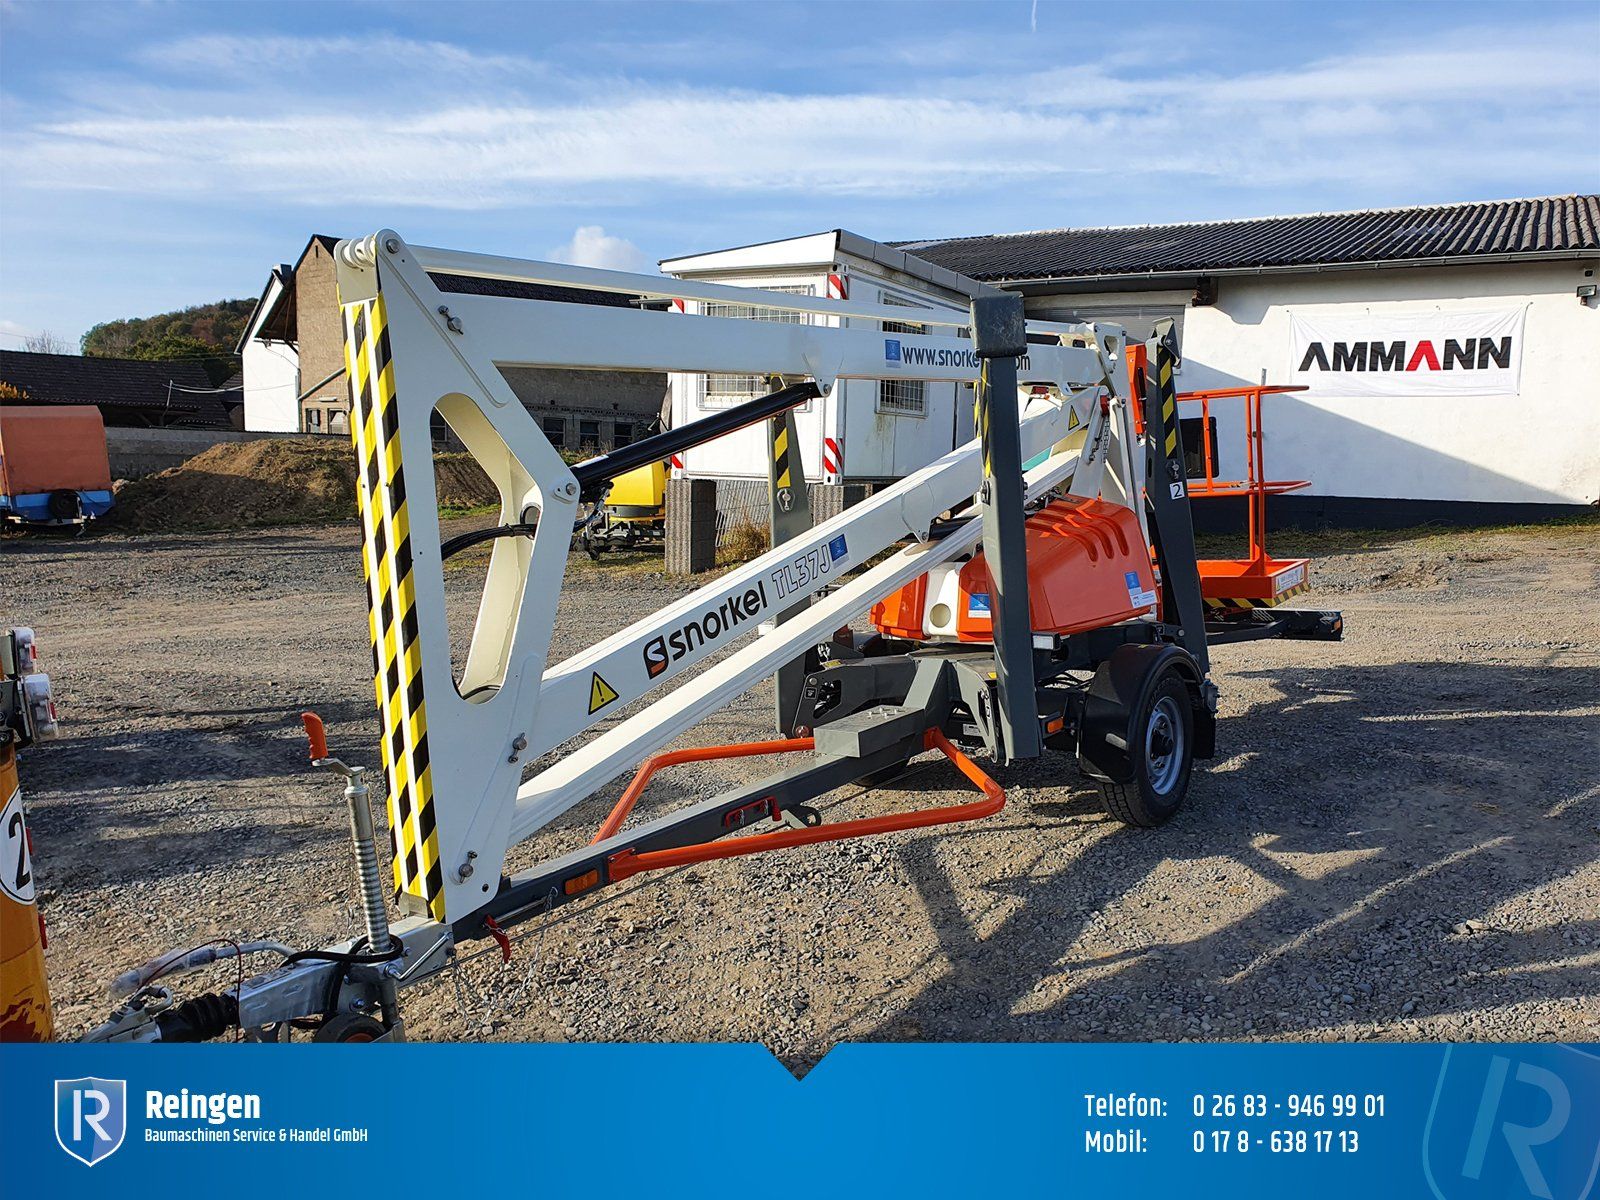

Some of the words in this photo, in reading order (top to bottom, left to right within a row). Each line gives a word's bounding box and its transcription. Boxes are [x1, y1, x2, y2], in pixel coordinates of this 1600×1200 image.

[1298, 336, 1513, 372] AMMANN
[1172, 483, 1183, 498] 2
[668, 580, 768, 661] snorkel
[771, 544, 831, 600] TL37J
[8, 811, 31, 891] 2
